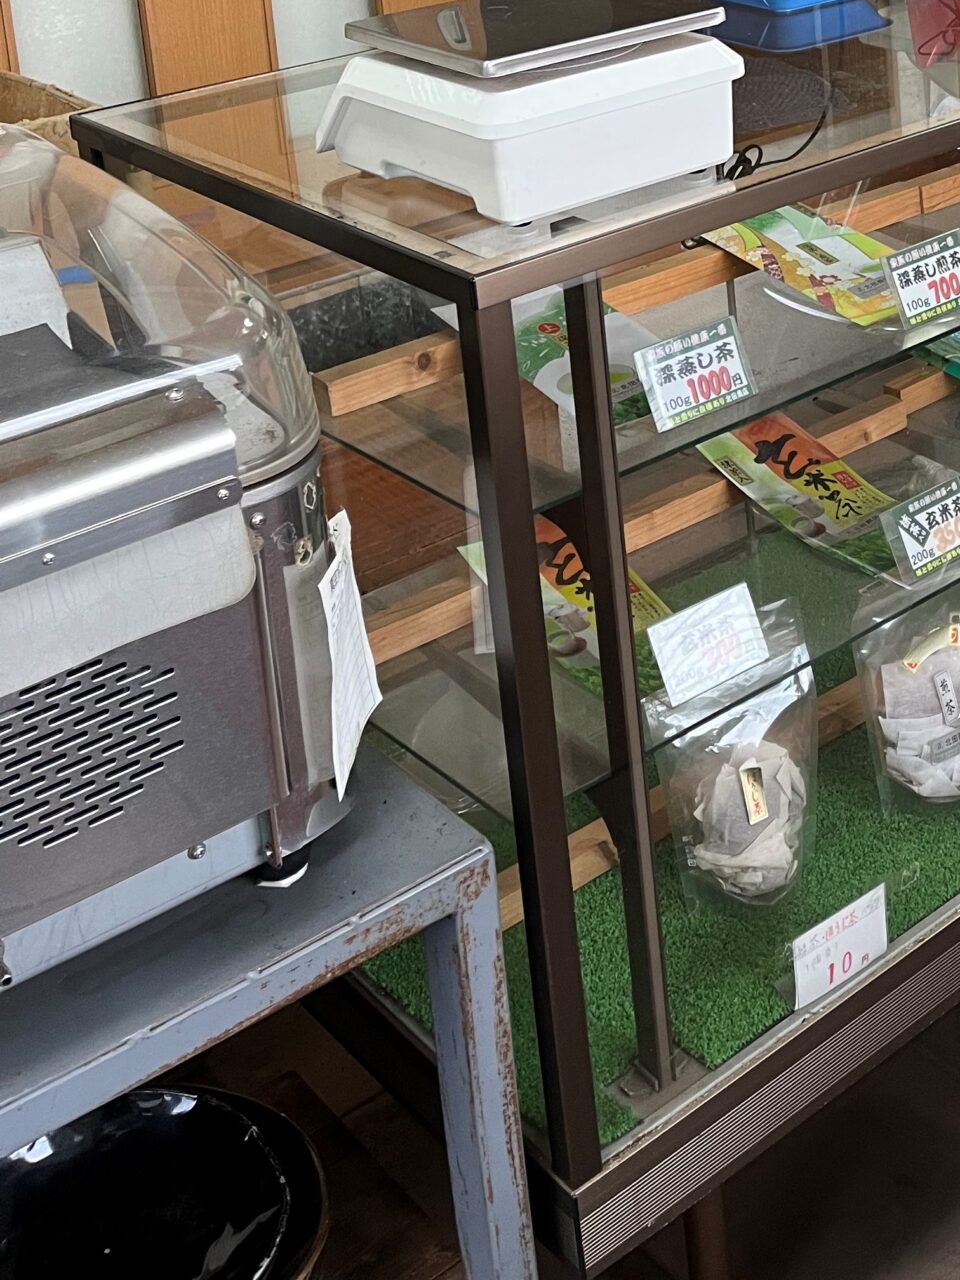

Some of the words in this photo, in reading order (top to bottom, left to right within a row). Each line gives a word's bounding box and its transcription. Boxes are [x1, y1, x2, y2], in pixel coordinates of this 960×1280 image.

[906, 298, 931, 313] 100g
[655, 342, 735, 387] 深蒸し茶
[664, 394, 692, 413] 100g
[911, 548, 936, 566] 200g
[939, 678, 956, 716] 煎茶
